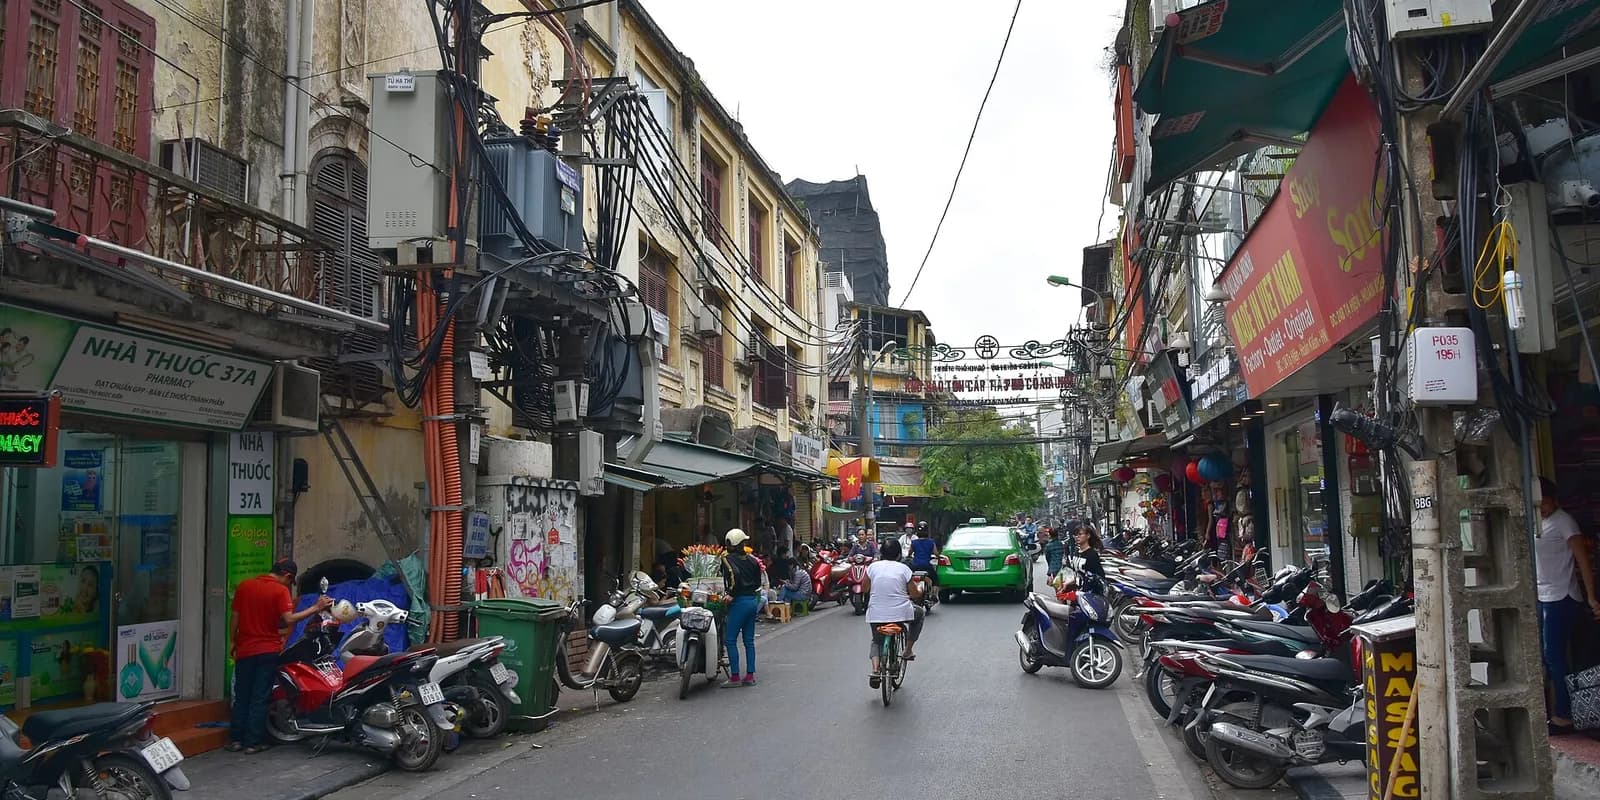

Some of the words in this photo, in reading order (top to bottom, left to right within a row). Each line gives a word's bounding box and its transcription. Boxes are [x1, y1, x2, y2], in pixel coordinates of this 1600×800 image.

[1231, 303, 1257, 350] MADE
[1248, 288, 1265, 331] IN
[1257, 273, 1281, 324] VIET
[1272, 249, 1303, 309] NAM
[1243, 347, 1266, 374] Factory
[1263, 331, 1284, 357] Outlet
[1284, 300, 1314, 341] Original
[1435, 349, 1461, 360] 195H
[82, 336, 136, 364] NHÀ
[145, 348, 222, 379] THUỐC
[223, 365, 258, 386] 37A
[145, 373, 194, 390] PHARMACY
[231, 459, 271, 481] THUỐC
[240, 492, 262, 509] 37A
[1365, 649, 1380, 800] MASSAG
